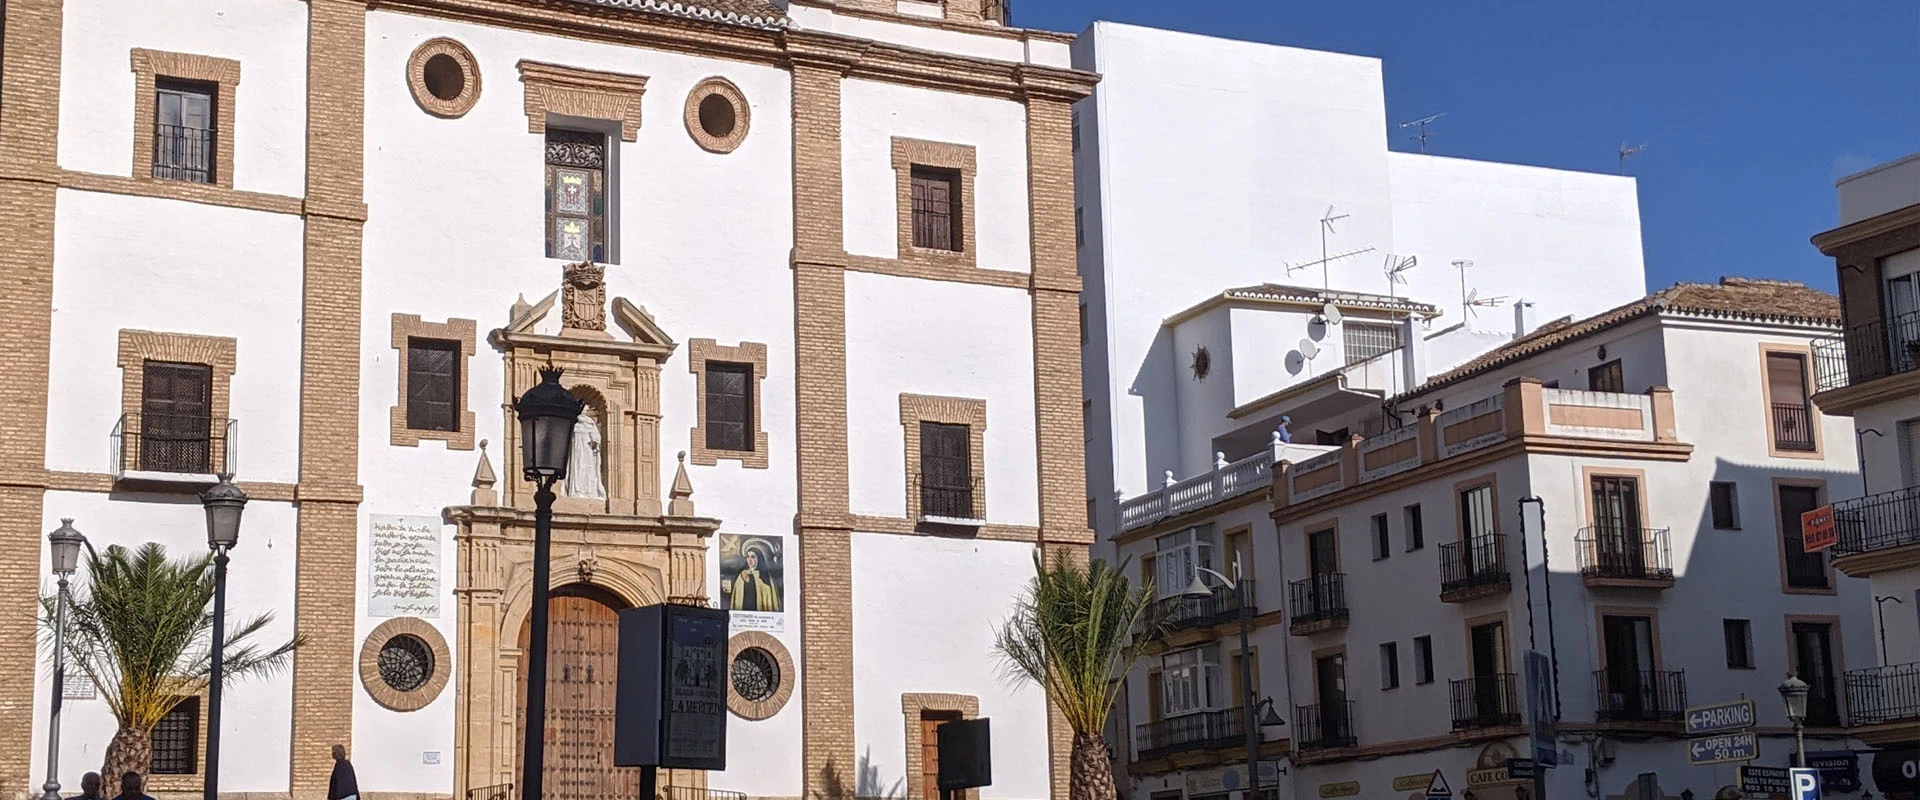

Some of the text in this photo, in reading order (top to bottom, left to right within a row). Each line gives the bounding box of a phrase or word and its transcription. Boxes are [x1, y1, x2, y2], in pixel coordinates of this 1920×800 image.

[1702, 705, 1749, 727] PARKING
[1705, 735, 1752, 750] OPEN 24H
[1714, 748, 1749, 760] 50 m.
[1470, 770, 1493, 783] CAFE
[1747, 768, 1761, 776] ESTE
[1762, 769, 1785, 778] ESPACIO
[1796, 773, 1816, 800] P
